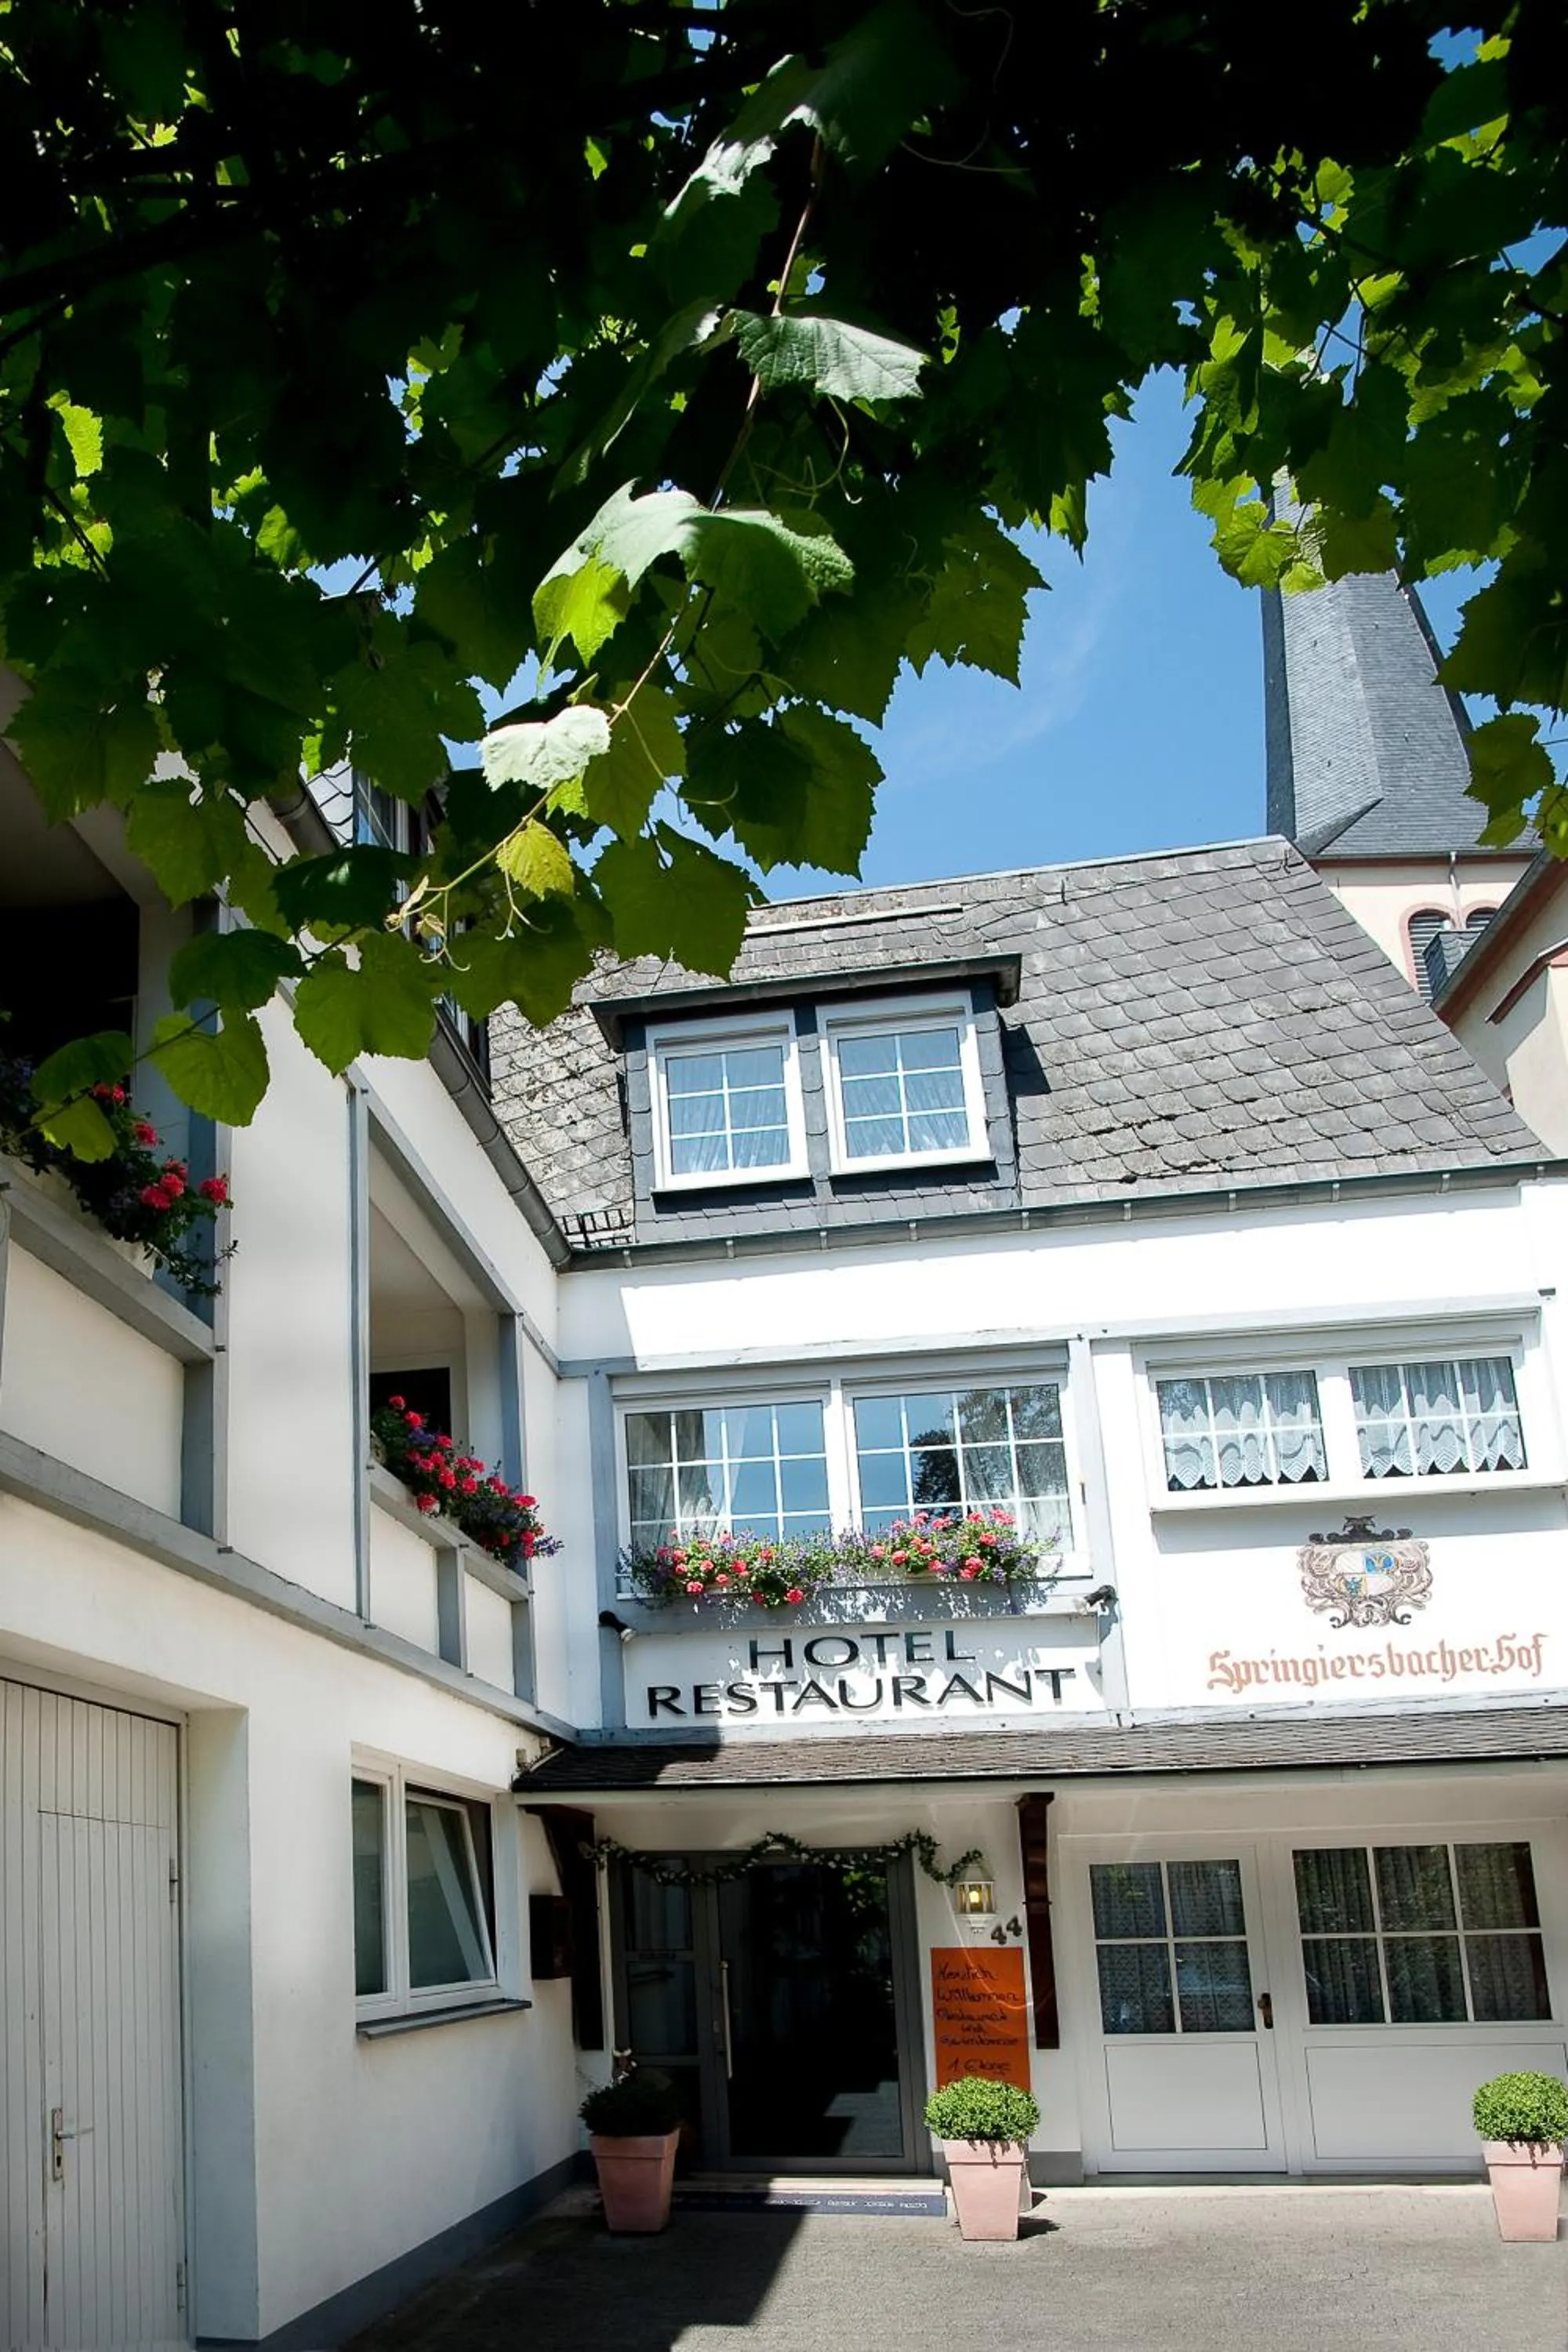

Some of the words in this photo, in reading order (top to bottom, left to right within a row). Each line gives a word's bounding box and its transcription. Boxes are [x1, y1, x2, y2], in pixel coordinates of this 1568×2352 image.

[749, 1630, 976, 1669] HOTEL
[647, 1667, 1075, 1718] RESTAURANT
[990, 1915, 1022, 1946] 44
